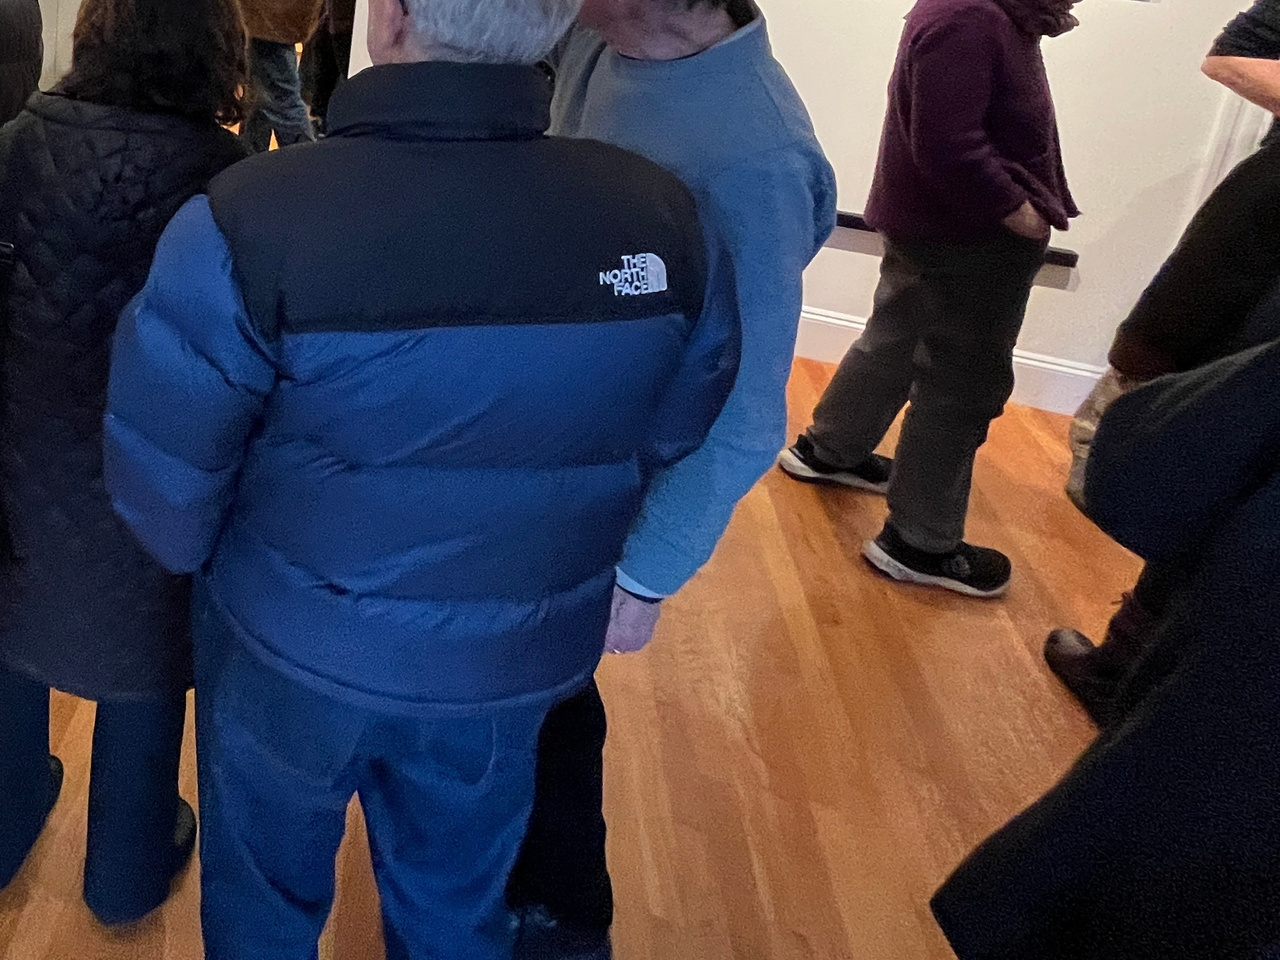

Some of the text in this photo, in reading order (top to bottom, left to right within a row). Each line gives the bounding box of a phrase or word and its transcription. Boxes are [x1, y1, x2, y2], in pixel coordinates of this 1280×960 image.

[621, 253, 647, 270] THE
[599, 268, 647, 285] NORTH
[614, 281, 649, 296] FACE
